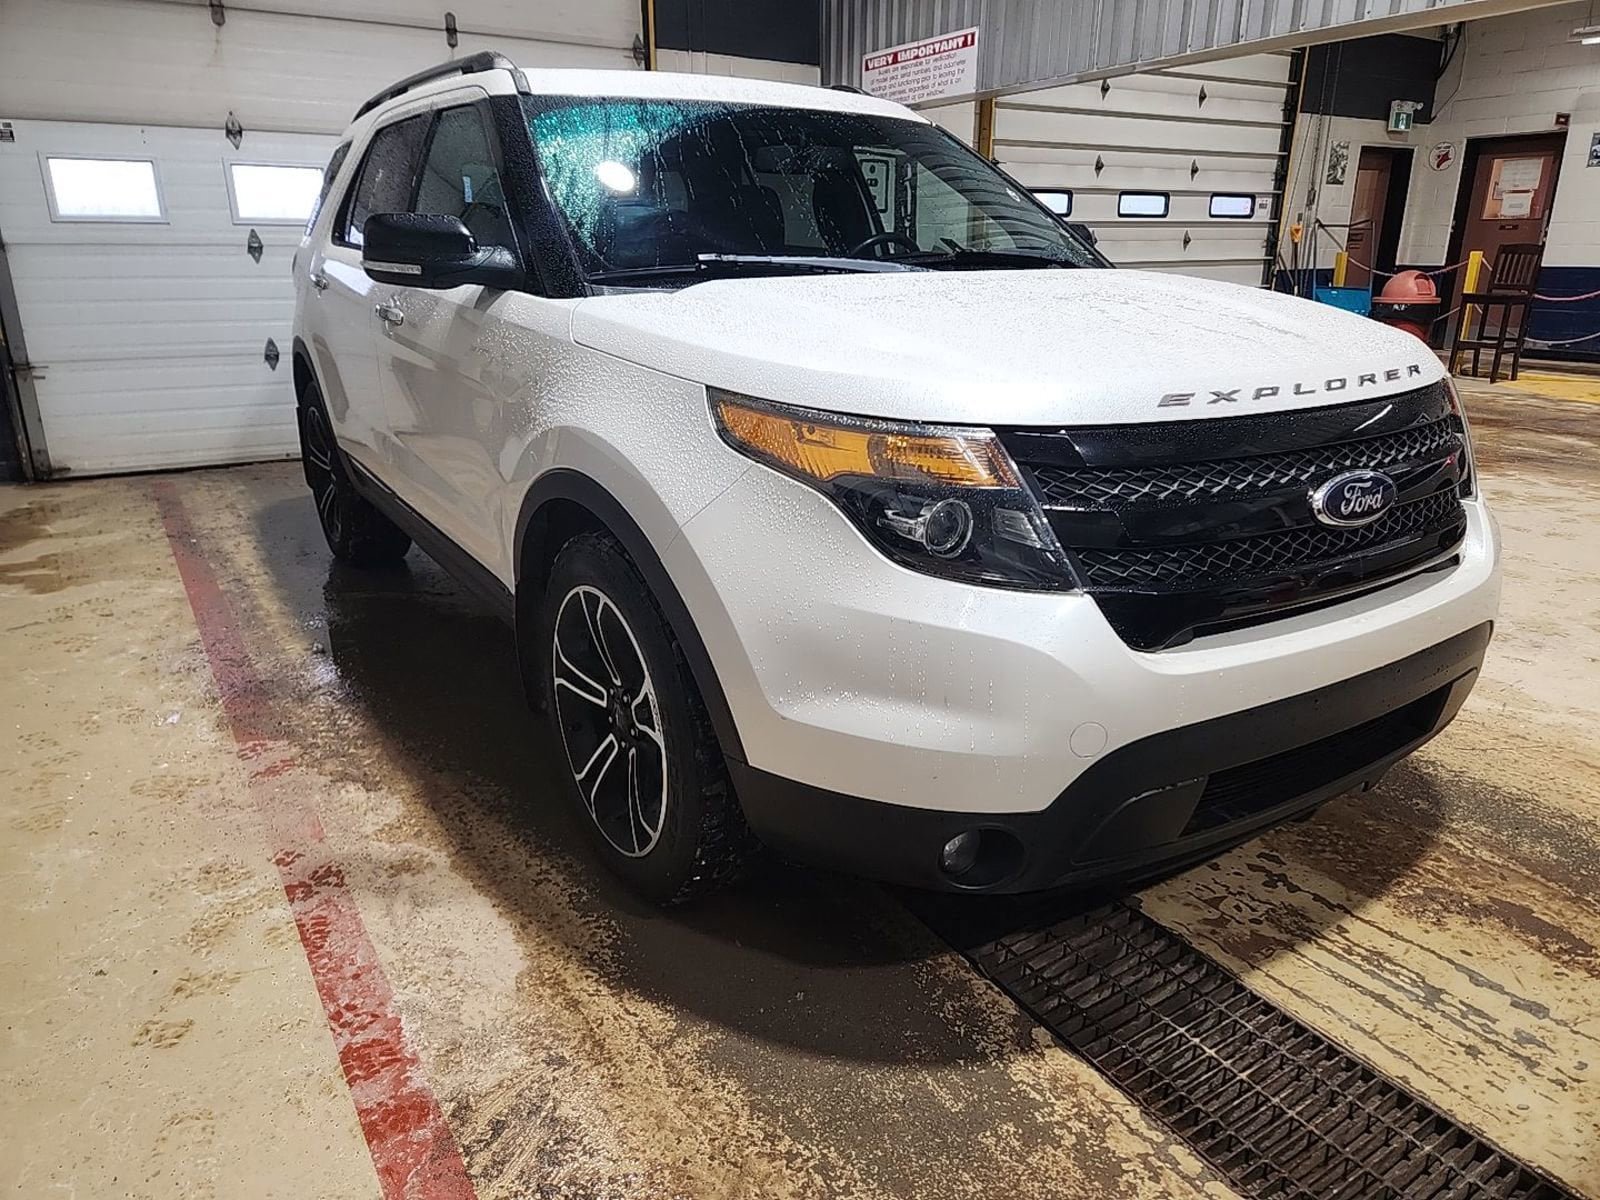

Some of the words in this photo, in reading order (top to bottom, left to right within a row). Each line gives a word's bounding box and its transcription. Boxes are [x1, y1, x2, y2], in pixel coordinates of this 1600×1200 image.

[867, 55, 894, 69] VERY
[898, 36, 965, 62] IMPORTANT
[1157, 364, 1422, 408] EXPLORER
[1341, 481, 1384, 516] Ford
